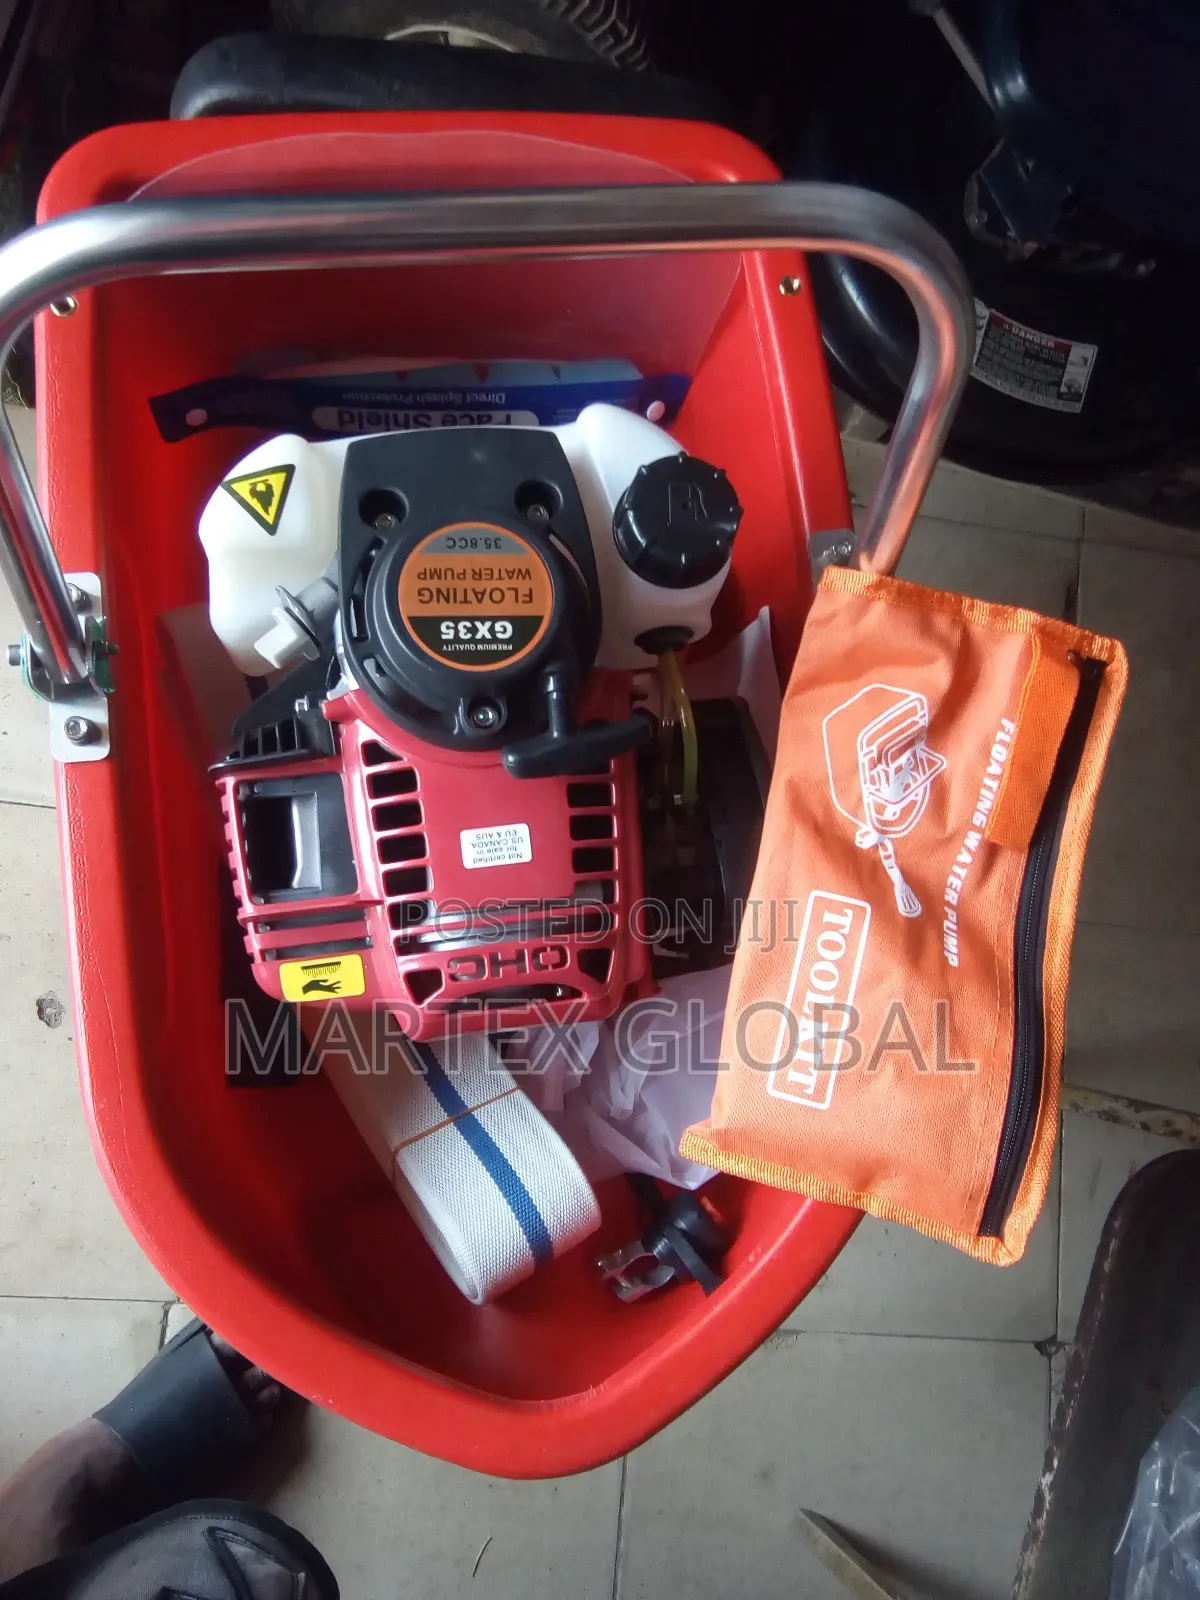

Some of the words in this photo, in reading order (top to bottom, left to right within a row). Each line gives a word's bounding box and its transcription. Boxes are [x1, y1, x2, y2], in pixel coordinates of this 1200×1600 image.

[1011, 326, 1055, 349] DANGER
[342, 391, 413, 405] Protection
[416, 391, 463, 406] Splash
[466, 391, 506, 405] Direct
[337, 410, 432, 432] Shield
[446, 537, 502, 549] 35.8CC
[417, 567, 467, 581] PUMP
[471, 567, 532, 581] WATER
[417, 587, 534, 605] FLOATING
[440, 621, 513, 640] GX35
[442, 644, 476, 652] QUALITY
[971, 717, 1016, 832] FLOATING
[504, 829, 517, 837] EU
[486, 847, 504, 855] sale
[508, 852, 523, 860] Not
[472, 854, 506, 864] certified
[943, 830, 983, 910] WATER
[942, 906, 960, 968] PUMP
[447, 944, 571, 982] OHC
[787, 907, 854, 1096] TOOLKIT
